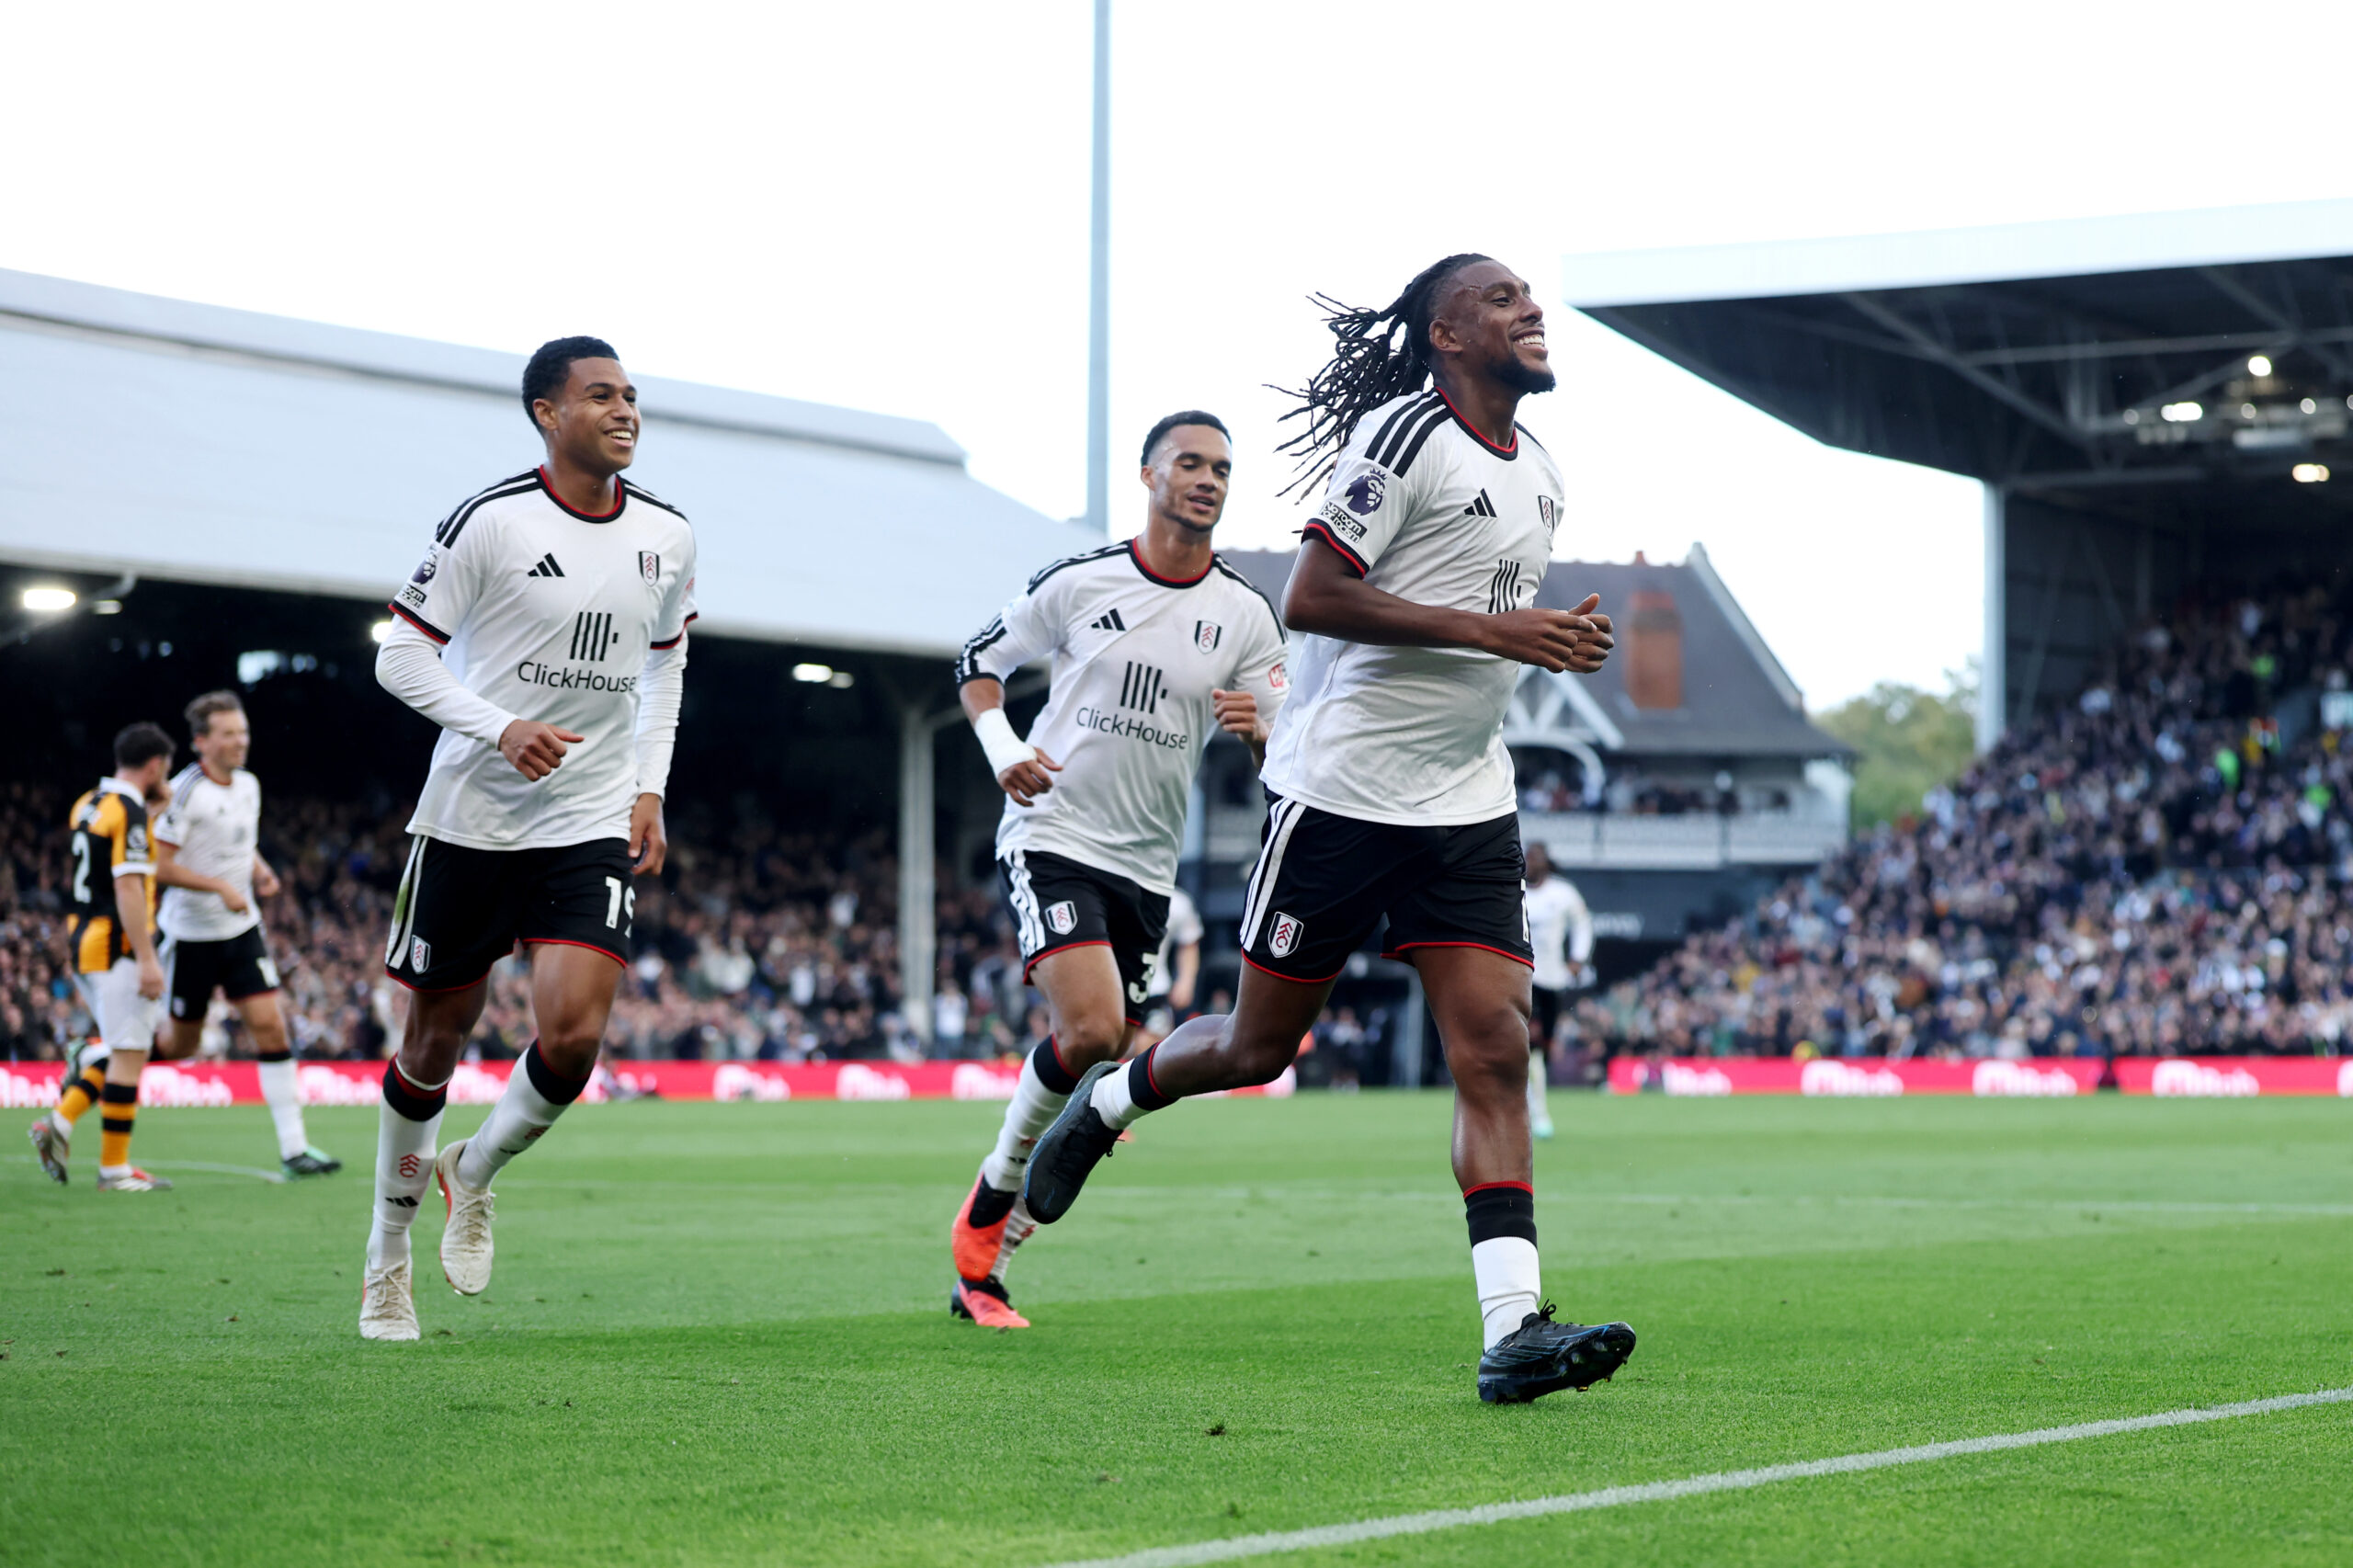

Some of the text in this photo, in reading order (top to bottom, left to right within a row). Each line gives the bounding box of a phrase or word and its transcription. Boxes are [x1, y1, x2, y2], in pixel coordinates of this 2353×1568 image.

[1323, 501, 1361, 534] No room
[1334, 517, 1360, 543] racism
[404, 585, 424, 602] oom
[517, 661, 637, 693] ClickHouse
[1076, 707, 1188, 750] ClickHouse
[72, 831, 91, 903] 2
